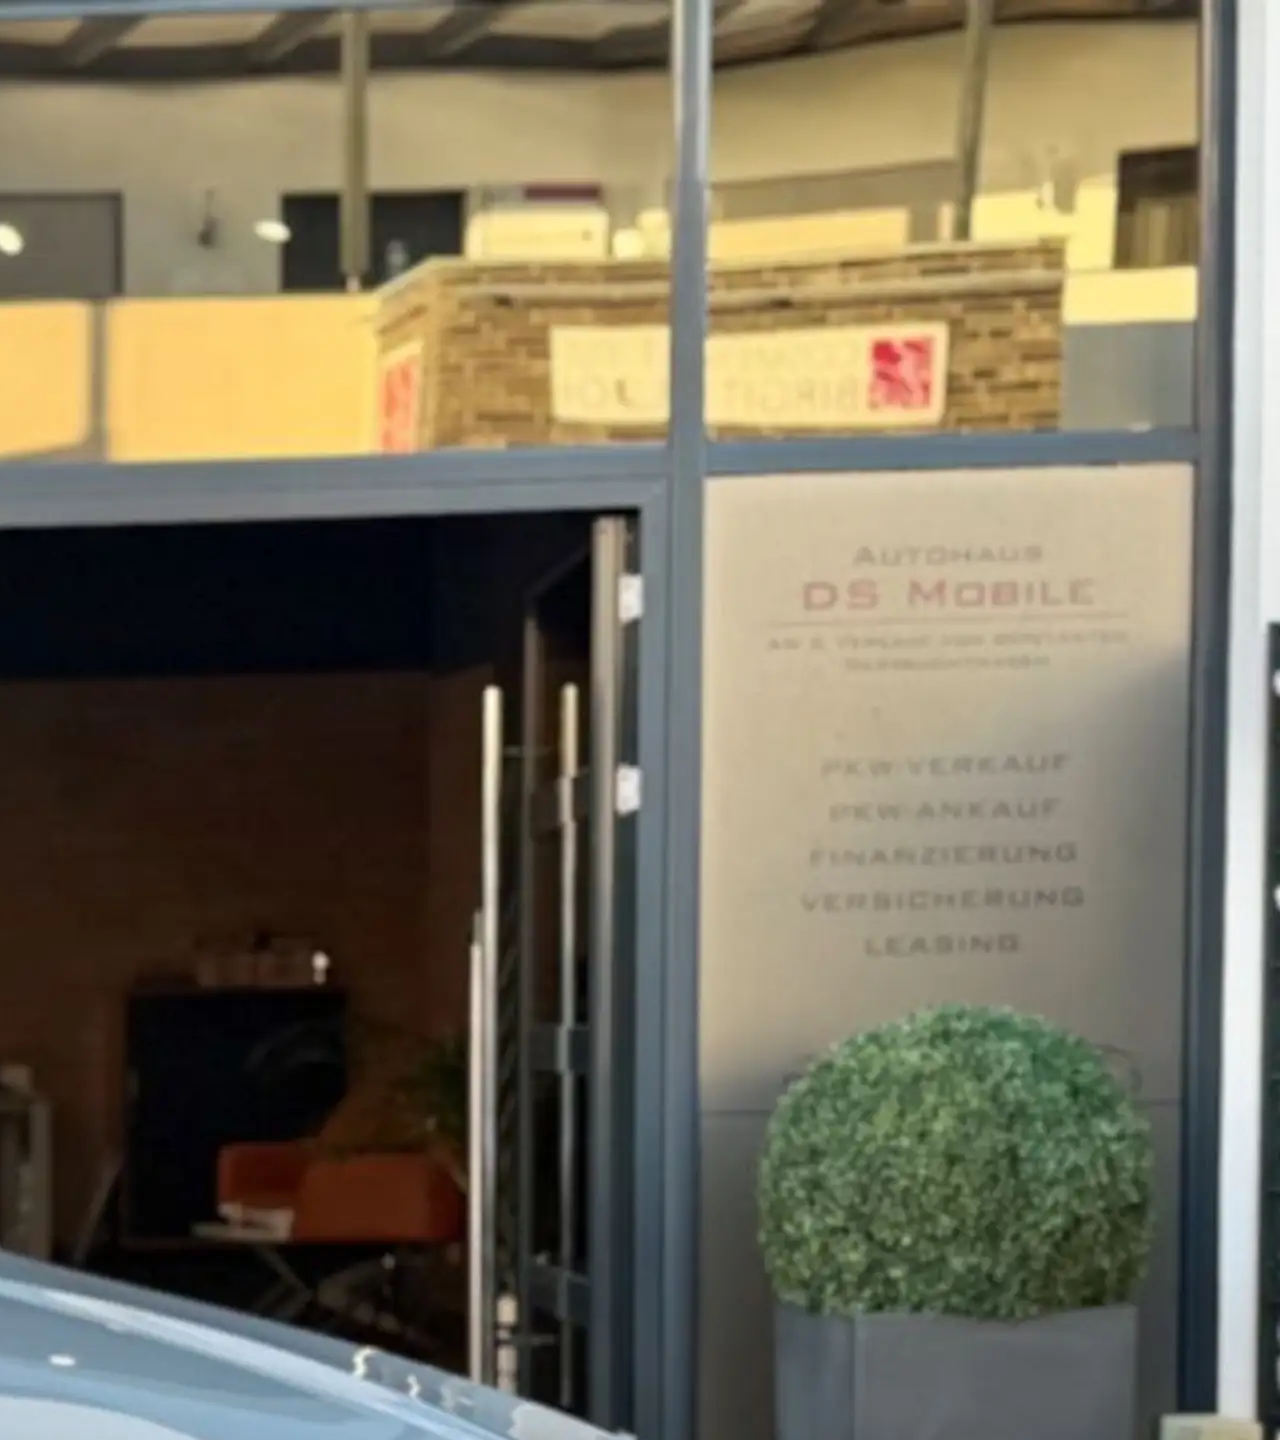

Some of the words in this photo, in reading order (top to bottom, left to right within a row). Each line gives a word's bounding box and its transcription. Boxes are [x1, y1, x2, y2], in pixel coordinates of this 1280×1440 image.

[852, 545, 1044, 567] AUTOHAUS
[801, 577, 880, 612] DS
[906, 577, 1096, 608] MOBILE
